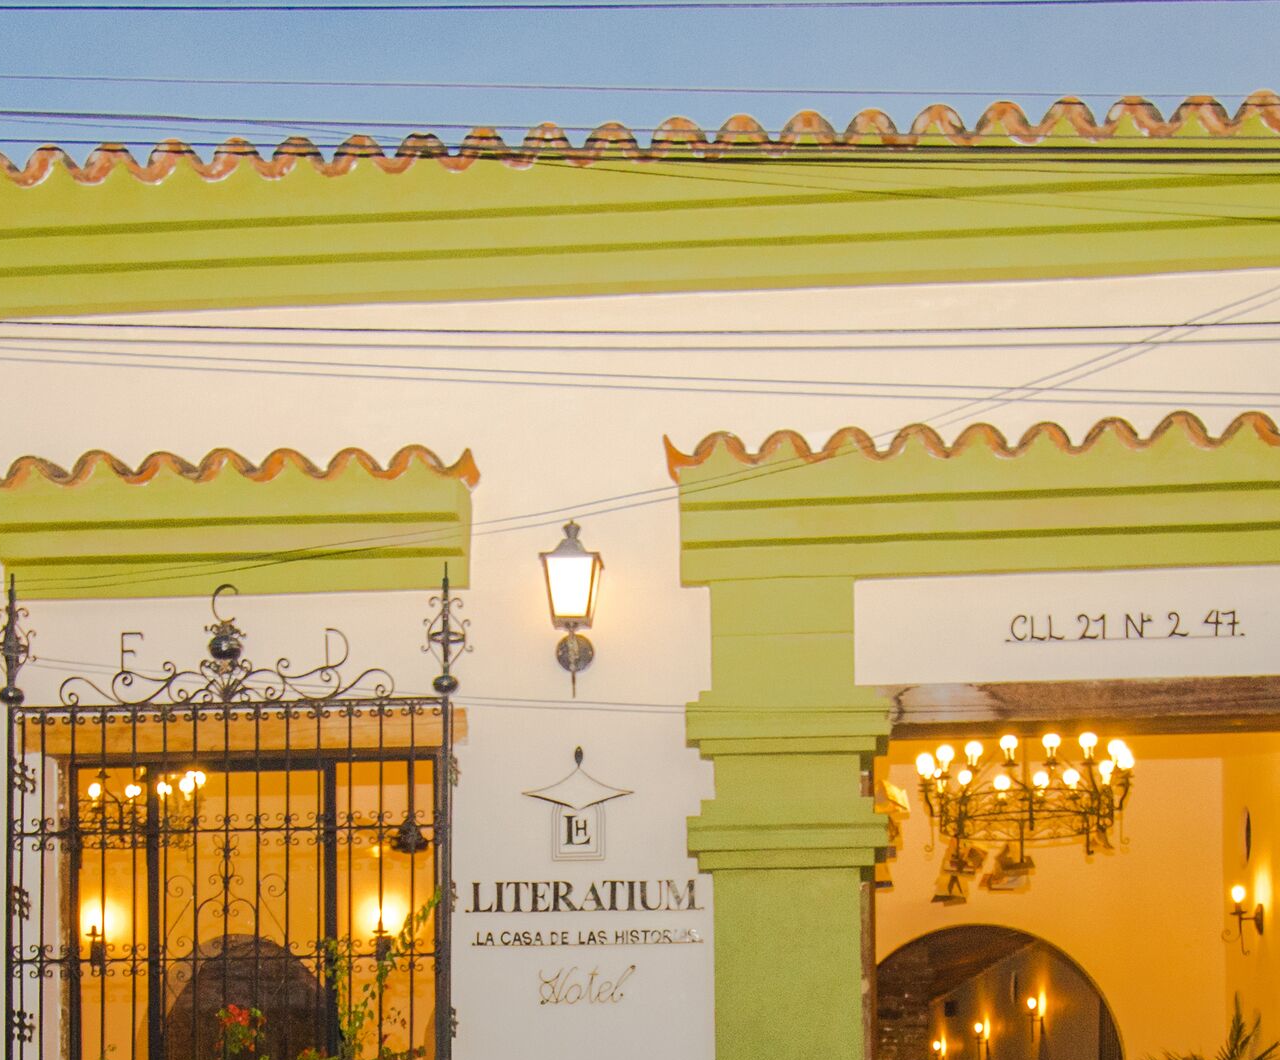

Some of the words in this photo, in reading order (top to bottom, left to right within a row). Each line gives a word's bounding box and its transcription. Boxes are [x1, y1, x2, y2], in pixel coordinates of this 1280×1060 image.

[1010, 613, 1066, 641] CLL
[1077, 613, 1107, 640] 21
[1167, 611, 1190, 638] 2
[1203, 610, 1241, 637] 47
[471, 878, 702, 914] LITERATIUM
[475, 930, 495, 946] LA
[500, 930, 545, 946] CASA
[550, 930, 570, 946] DE
[578, 929, 608, 945] LAS
[538, 964, 637, 1006] Hotel
